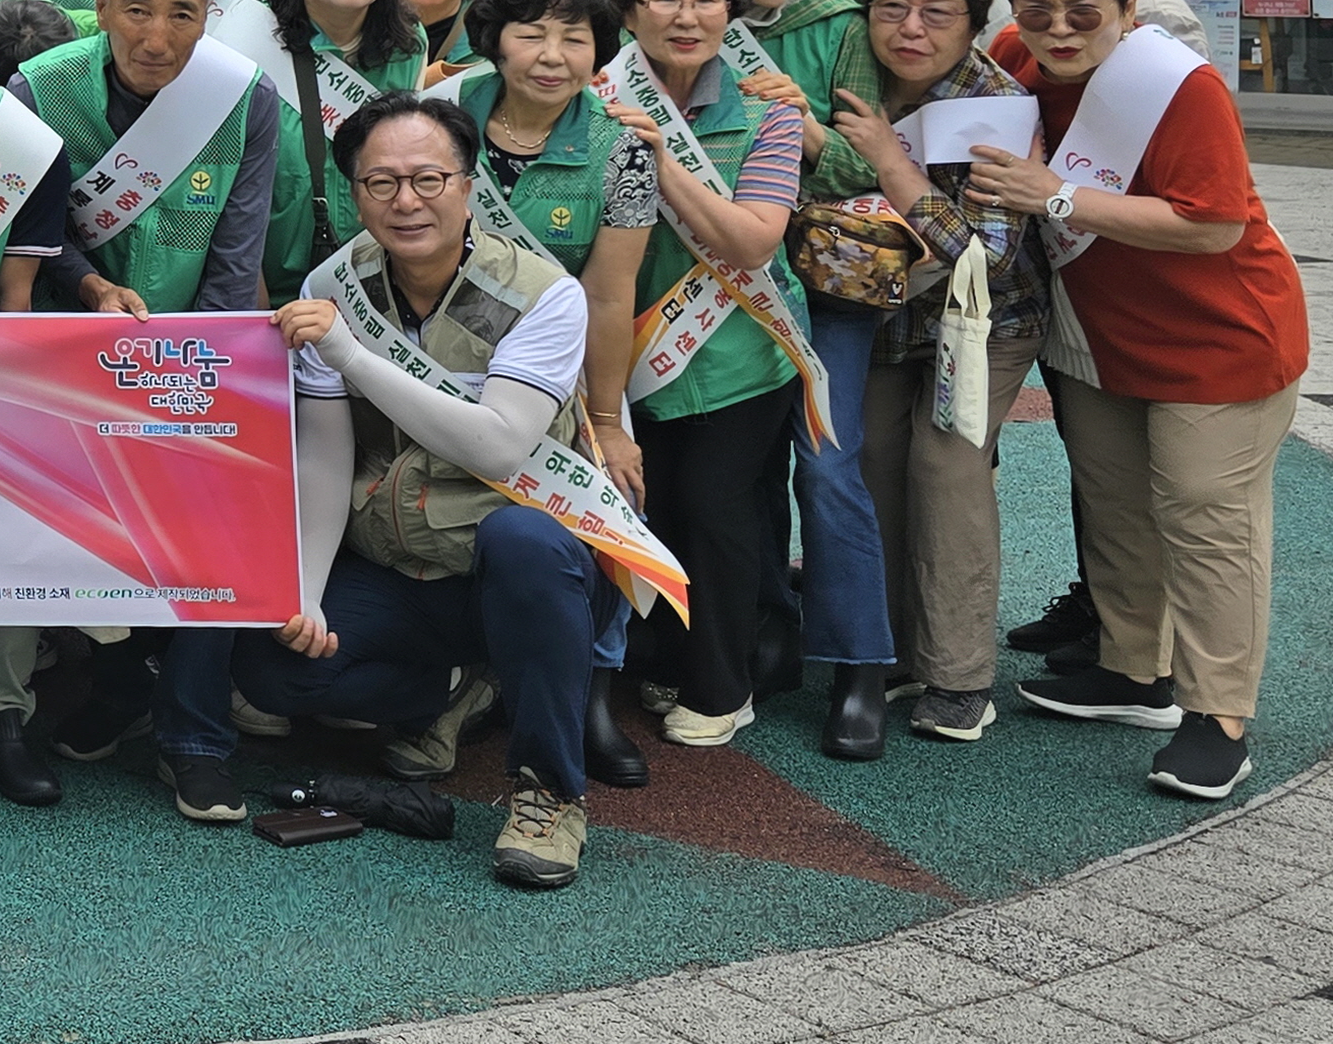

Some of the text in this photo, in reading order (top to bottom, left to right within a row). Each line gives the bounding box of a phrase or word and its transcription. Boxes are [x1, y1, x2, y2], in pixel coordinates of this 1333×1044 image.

[186, 193, 216, 206] SMU
[749, 290, 773, 314] 큰
[334, 261, 432, 381] 탄소중립 실천
[99, 338, 231, 388] 온기나눔
[139, 371, 197, 393] 하나되는
[151, 391, 213, 413] 대한민국
[98, 423, 110, 434] 더
[111, 423, 141, 434] 따뜻한
[142, 423, 192, 435] 대한민국을
[545, 450, 595, 489] 위한
[545, 492, 623, 546] 큰 힘!
[15, 587, 47, 600] 친환경
[49, 587, 71, 600] 소재
